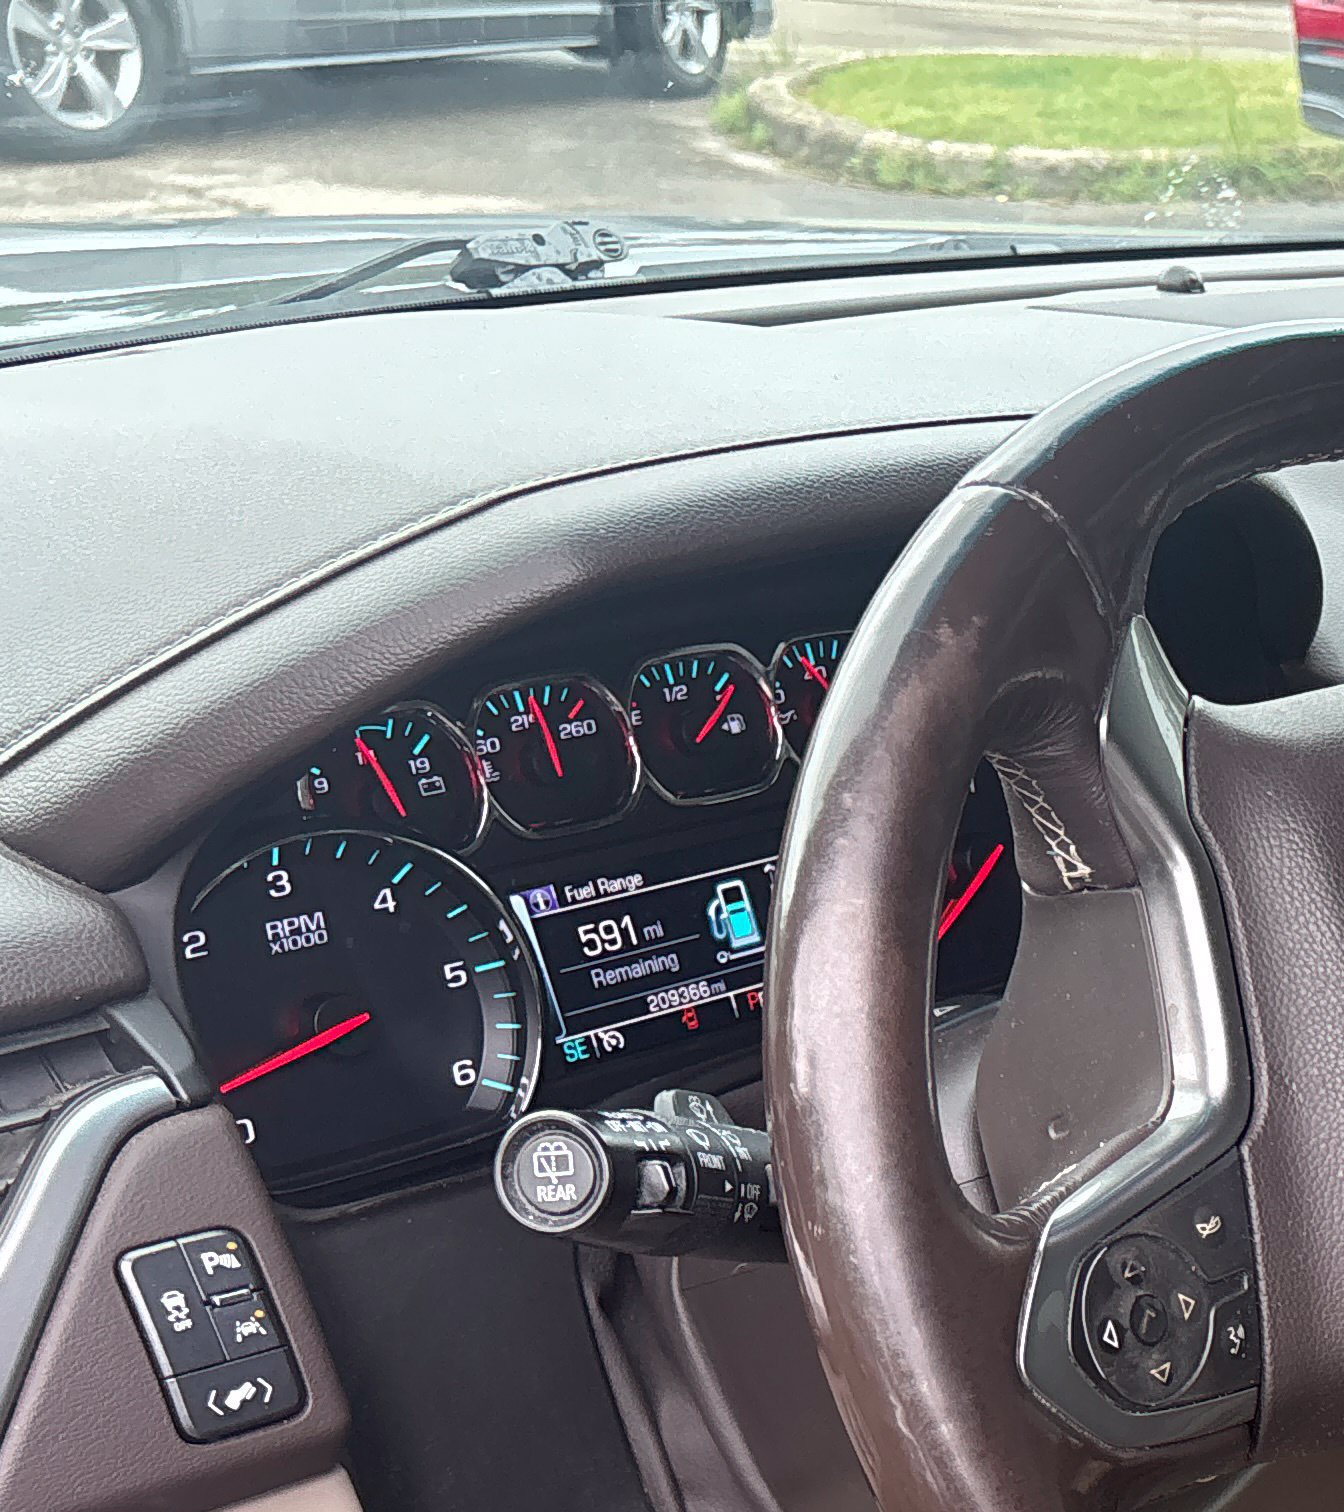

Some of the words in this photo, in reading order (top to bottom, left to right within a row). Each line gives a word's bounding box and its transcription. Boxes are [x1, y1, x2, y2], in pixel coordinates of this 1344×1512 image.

[663, 685, 689, 702] 1/2
[558, 719, 597, 740] 260
[408, 758, 432, 775] 19
[312, 778, 329, 794] 9
[266, 870, 292, 898] 3
[564, 881, 594, 903] Fuel
[596, 872, 644, 896] Range
[373, 888, 397, 913] 4
[265, 911, 326, 941] RPM
[577, 914, 638, 957] 591
[642, 920, 665, 941] mi
[182, 930, 209, 960] 2
[443, 961, 468, 988] 5
[590, 952, 681, 989] Remaining
[563, 1037, 592, 1064] SE
[452, 1060, 476, 1087] 6
[696, 1151, 727, 1171] FRONT
[536, 1184, 577, 1202] REAR
